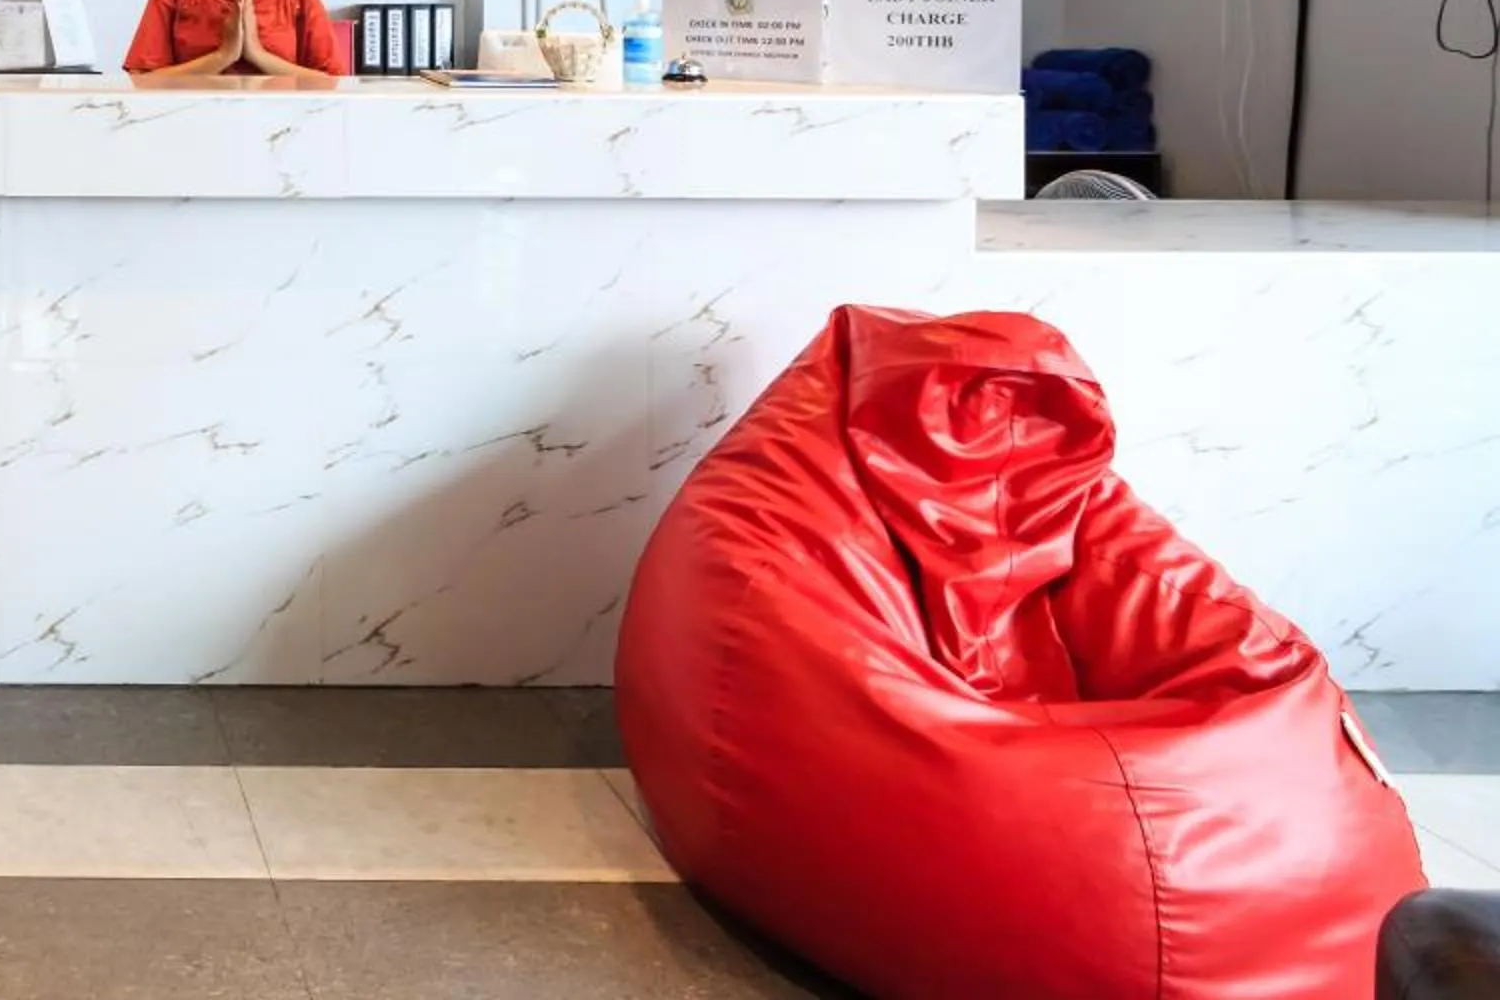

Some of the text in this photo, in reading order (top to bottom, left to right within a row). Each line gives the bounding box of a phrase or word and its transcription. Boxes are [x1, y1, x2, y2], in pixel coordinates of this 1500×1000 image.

[689, 19, 716, 29] CHECK
[731, 20, 753, 29] TIME
[785, 21, 801, 30] PM
[887, 12, 968, 25] CHARGE
[789, 37, 805, 46] PM
[887, 35, 954, 48] 200THB
